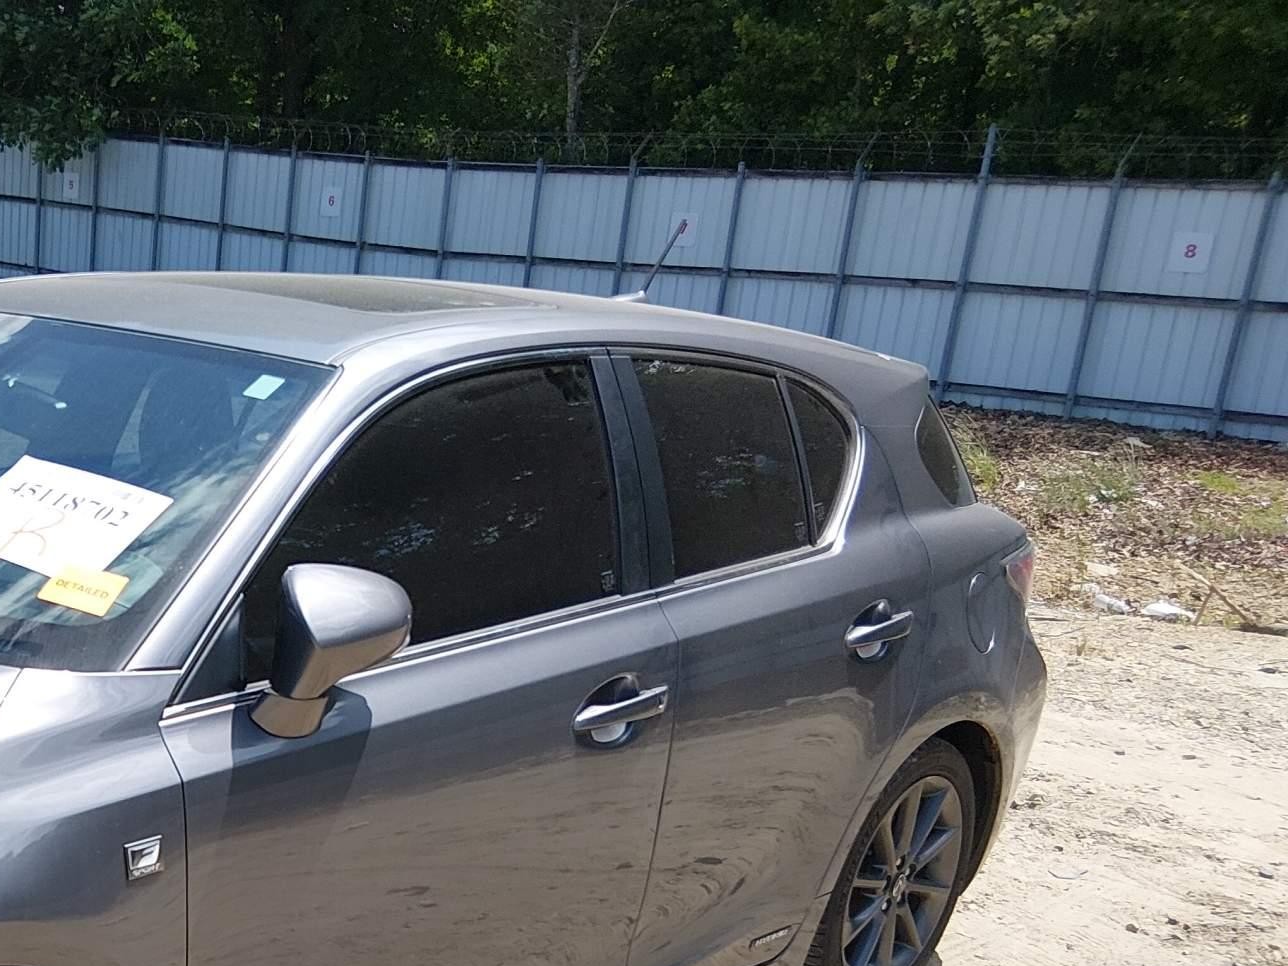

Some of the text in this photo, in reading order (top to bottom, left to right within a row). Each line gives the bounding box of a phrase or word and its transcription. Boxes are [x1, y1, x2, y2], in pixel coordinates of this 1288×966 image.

[328, 195, 335, 207] 6
[1184, 244, 1197, 258] 8
[9, 481, 131, 528] 45118702
[54, 577, 111, 601] DETAILED
